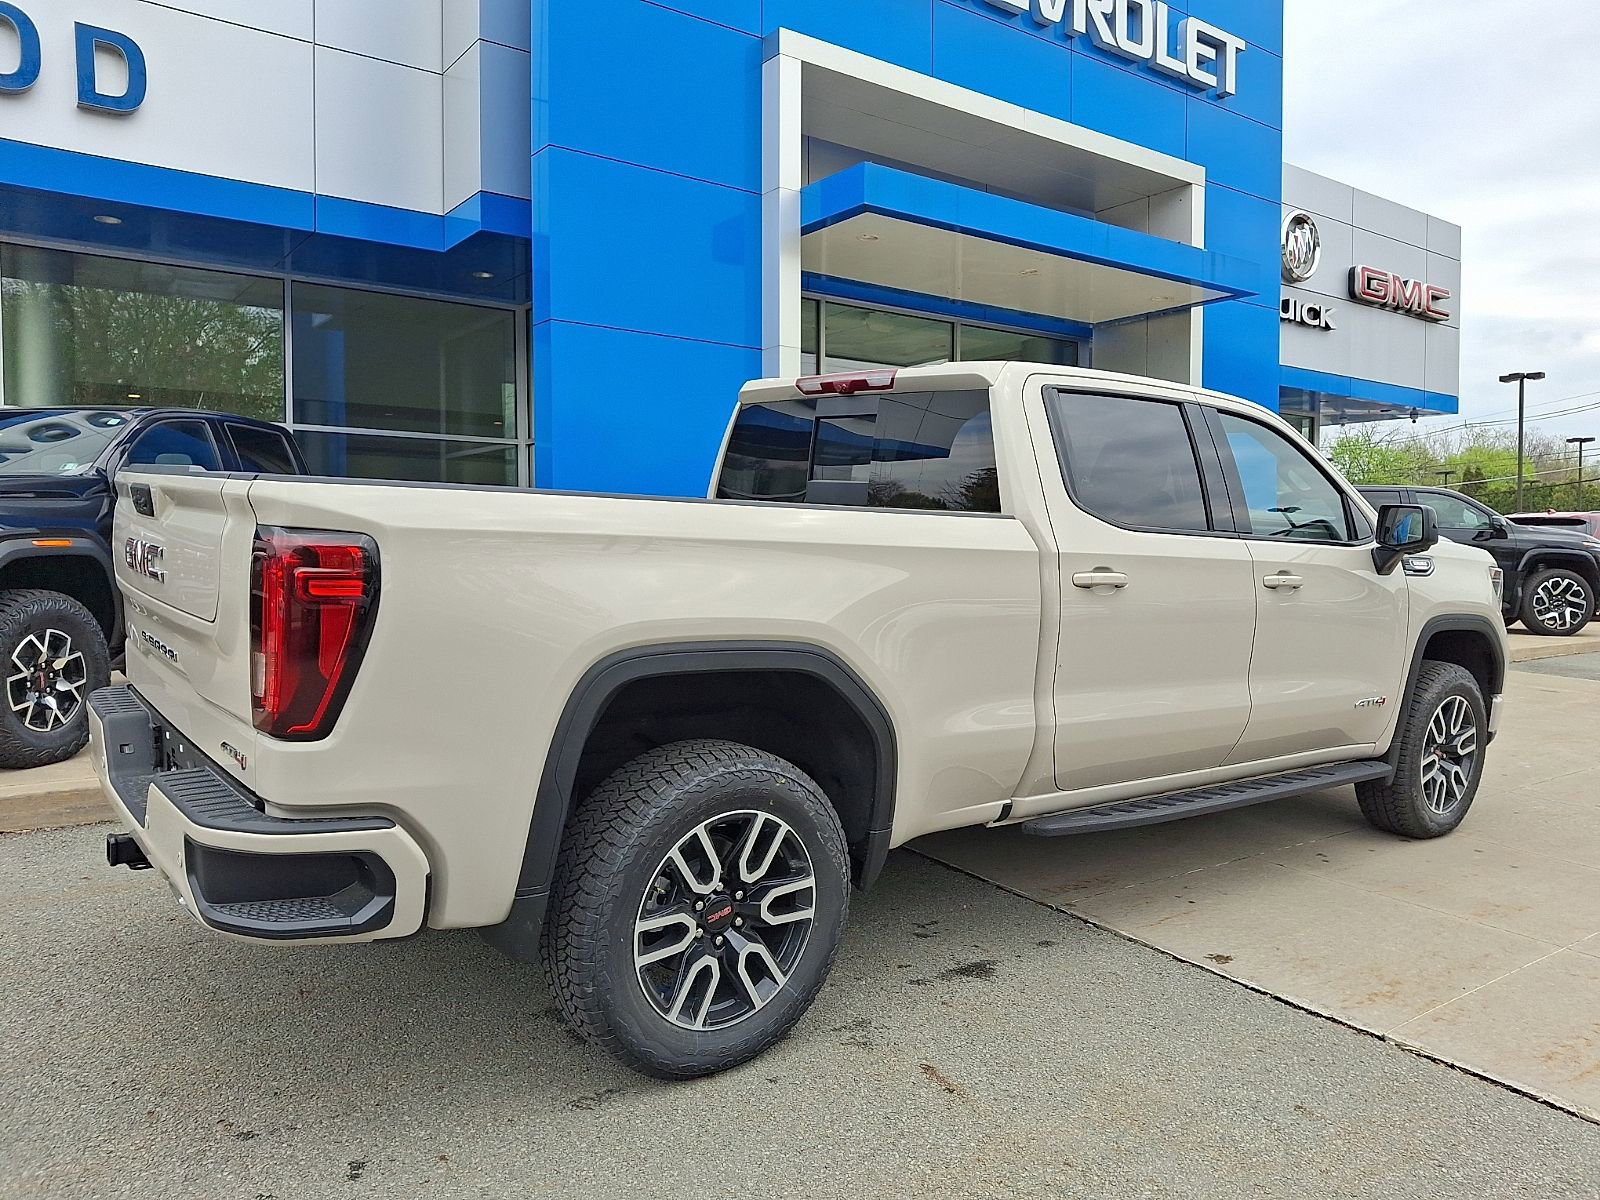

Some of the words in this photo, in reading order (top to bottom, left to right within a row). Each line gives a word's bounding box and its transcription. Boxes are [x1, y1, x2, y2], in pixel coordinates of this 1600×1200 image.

[984, 0, 1246, 97] ROLET
[1348, 264, 1451, 321] GMC
[125, 536, 165, 584] GMC
[1353, 695, 1387, 709] AT4
[219, 740, 247, 770] AT4
